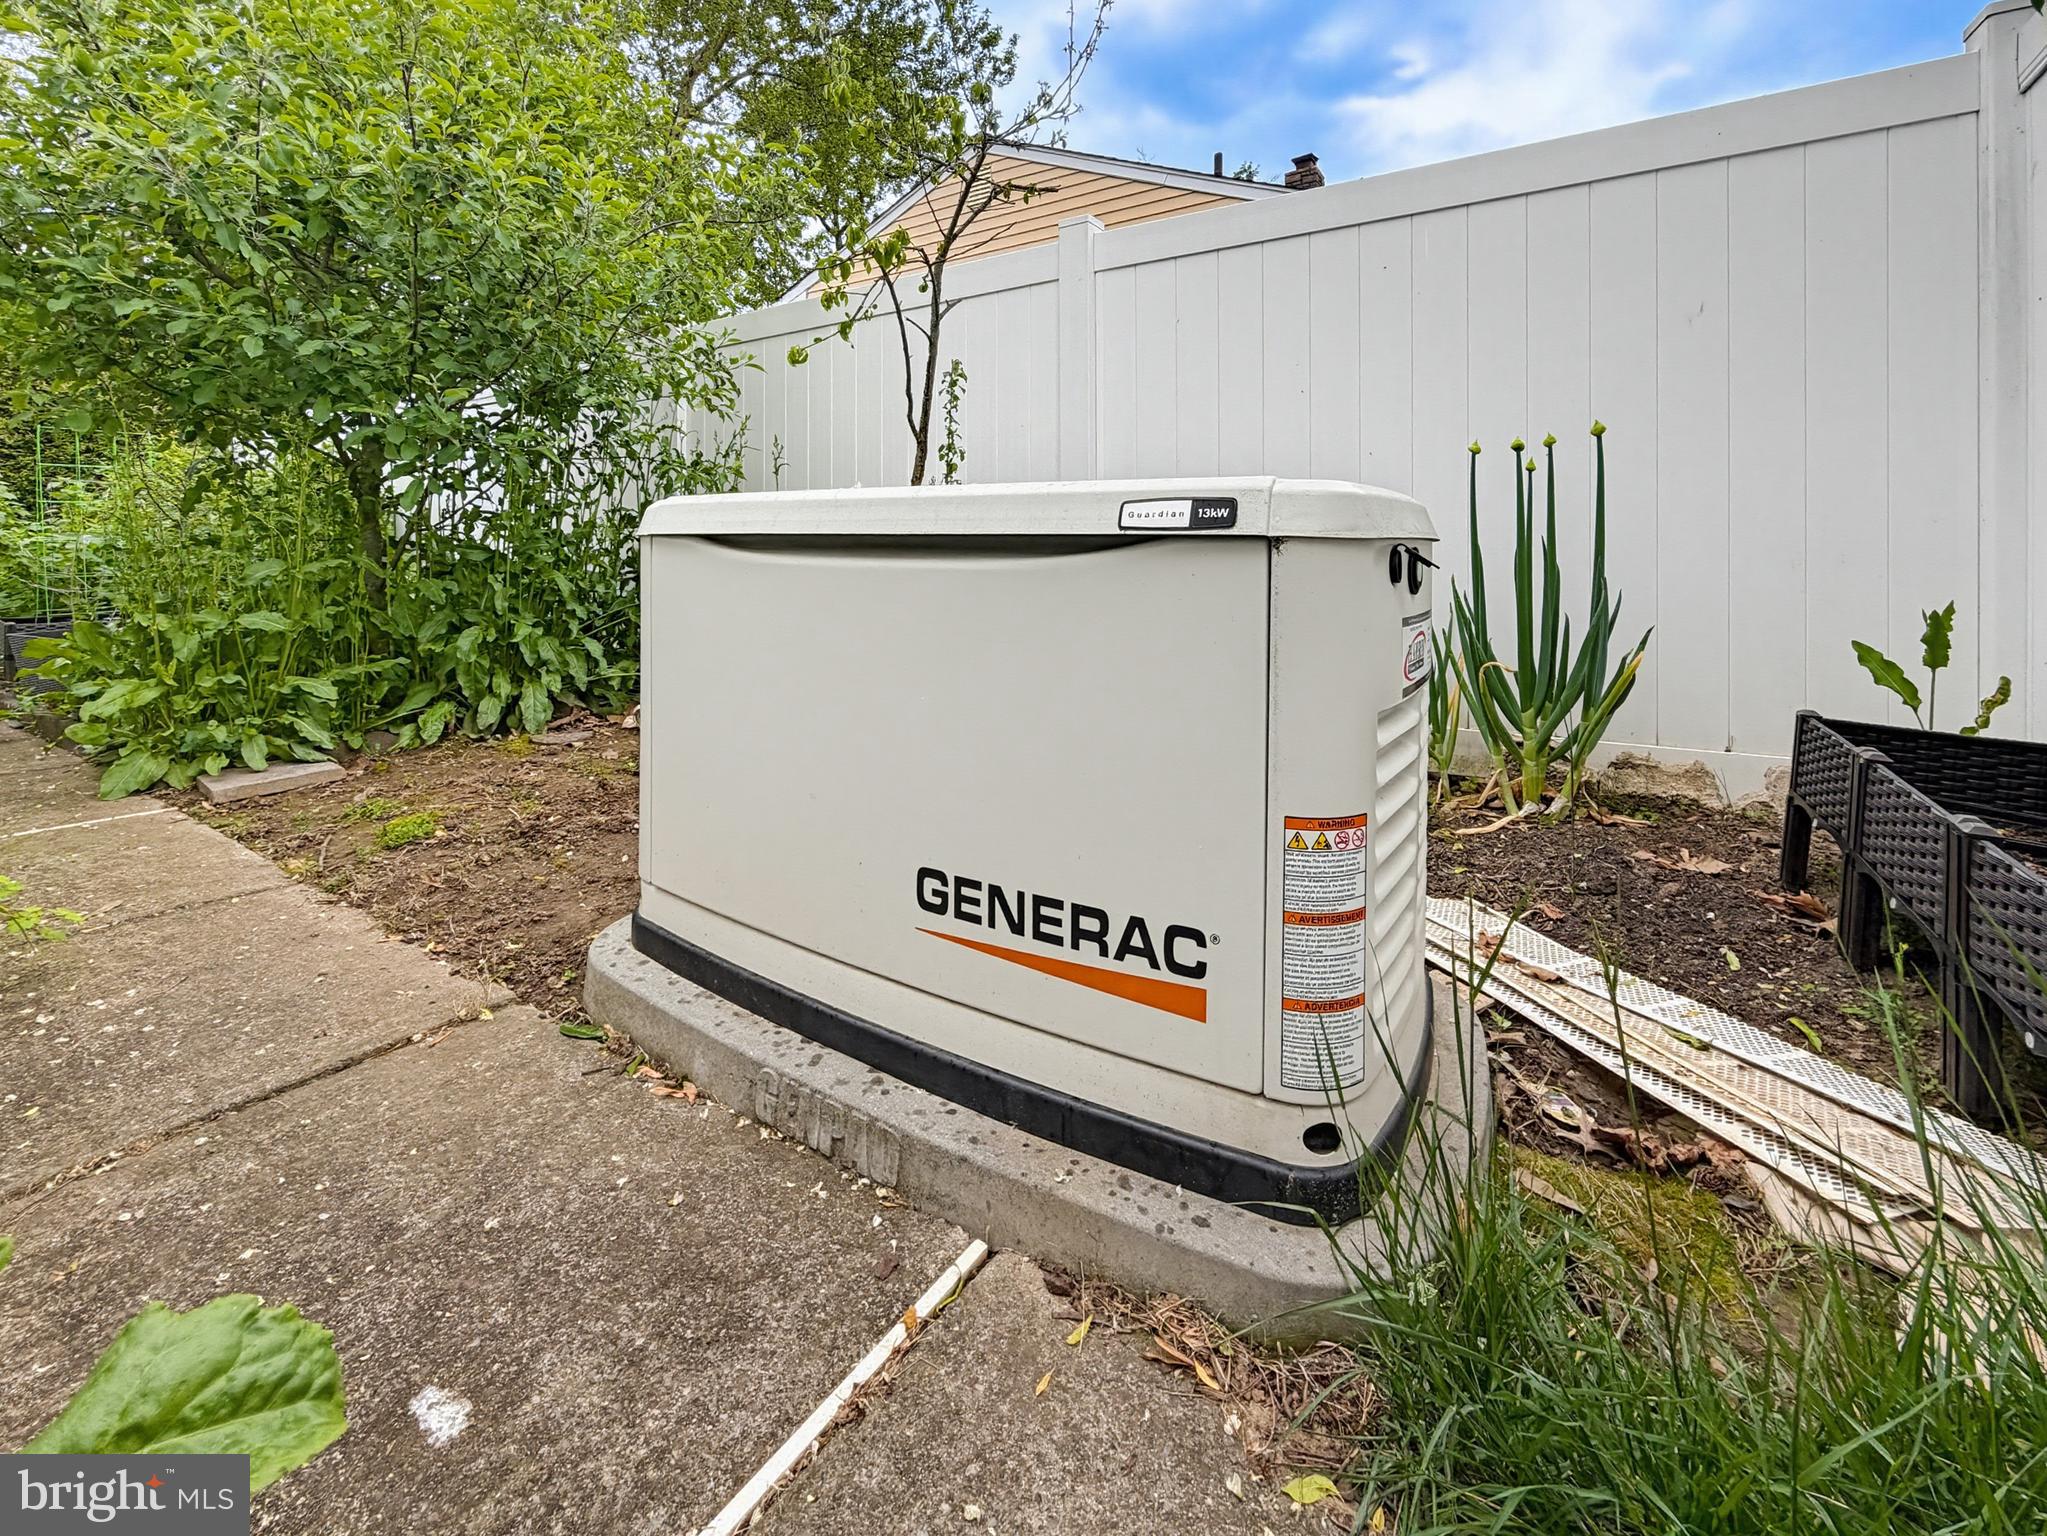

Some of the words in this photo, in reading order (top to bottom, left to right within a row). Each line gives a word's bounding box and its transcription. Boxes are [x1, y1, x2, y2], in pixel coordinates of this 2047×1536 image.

[1127, 510, 1185, 519] Guardian
[1198, 508, 1230, 518] 13kW
[1317, 818, 1356, 829] WARNING
[1299, 909, 1364, 925] AVERTISSEMENT
[1304, 997, 1360, 1011] ADVERTENCIA
